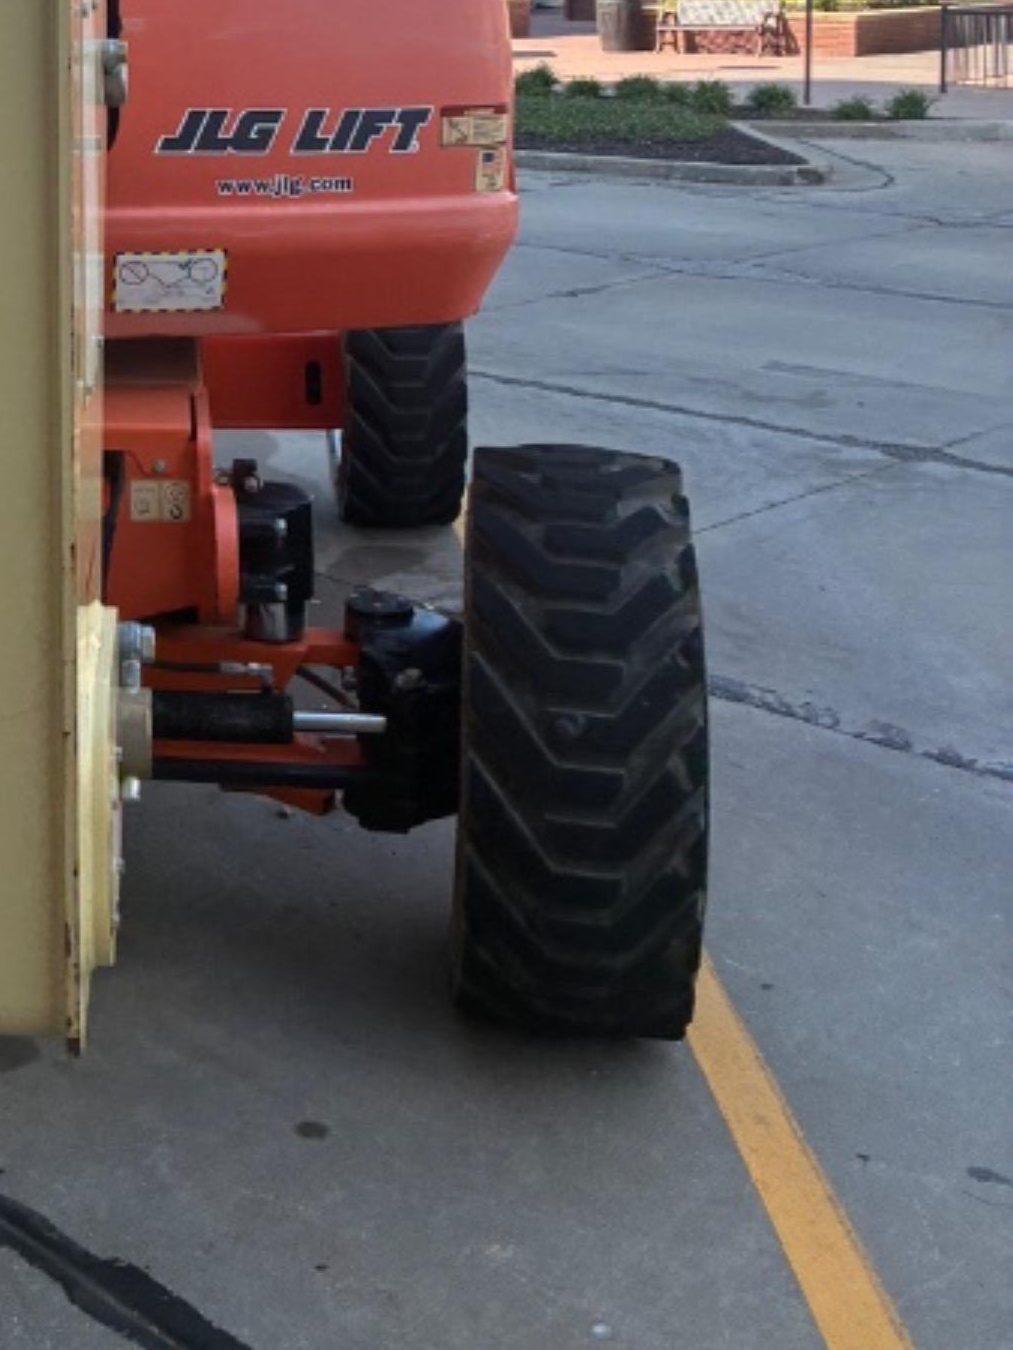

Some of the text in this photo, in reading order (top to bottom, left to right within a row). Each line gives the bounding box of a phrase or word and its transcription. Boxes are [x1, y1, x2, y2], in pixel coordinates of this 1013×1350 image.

[155, 107, 287, 155] JLG
[290, 105, 435, 155] LIFT
[216, 174, 353, 197] www.jlg.com
